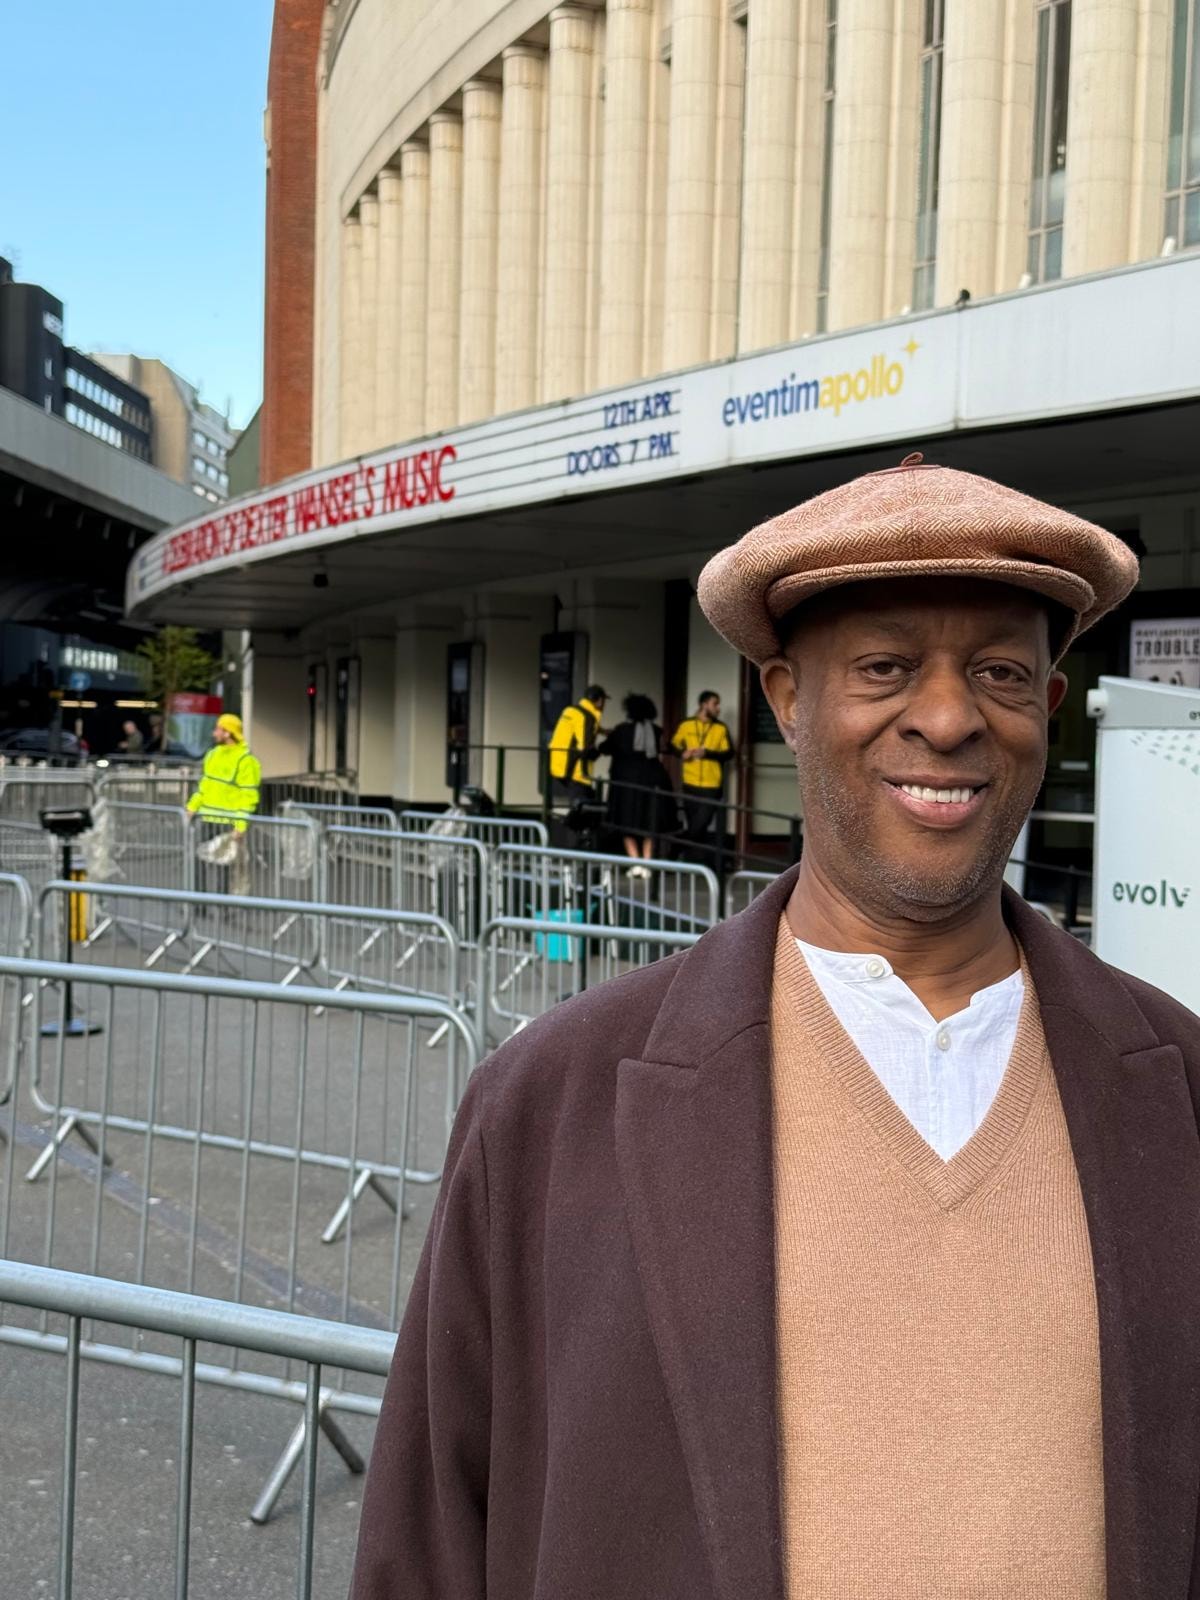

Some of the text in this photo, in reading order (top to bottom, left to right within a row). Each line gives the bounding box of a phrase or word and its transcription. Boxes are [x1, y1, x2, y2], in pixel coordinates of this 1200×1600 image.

[722, 354, 904, 427] eventimapollo
[603, 391, 672, 430] 12TH APR
[567, 442, 620, 476] DOORS
[629, 439, 640, 465] 7
[294, 462, 376, 535] WANSEL'S
[382, 443, 458, 516] MUSIC
[1135, 638, 1200, 656] TROUBLE
[1113, 880, 1189, 908] evolv
